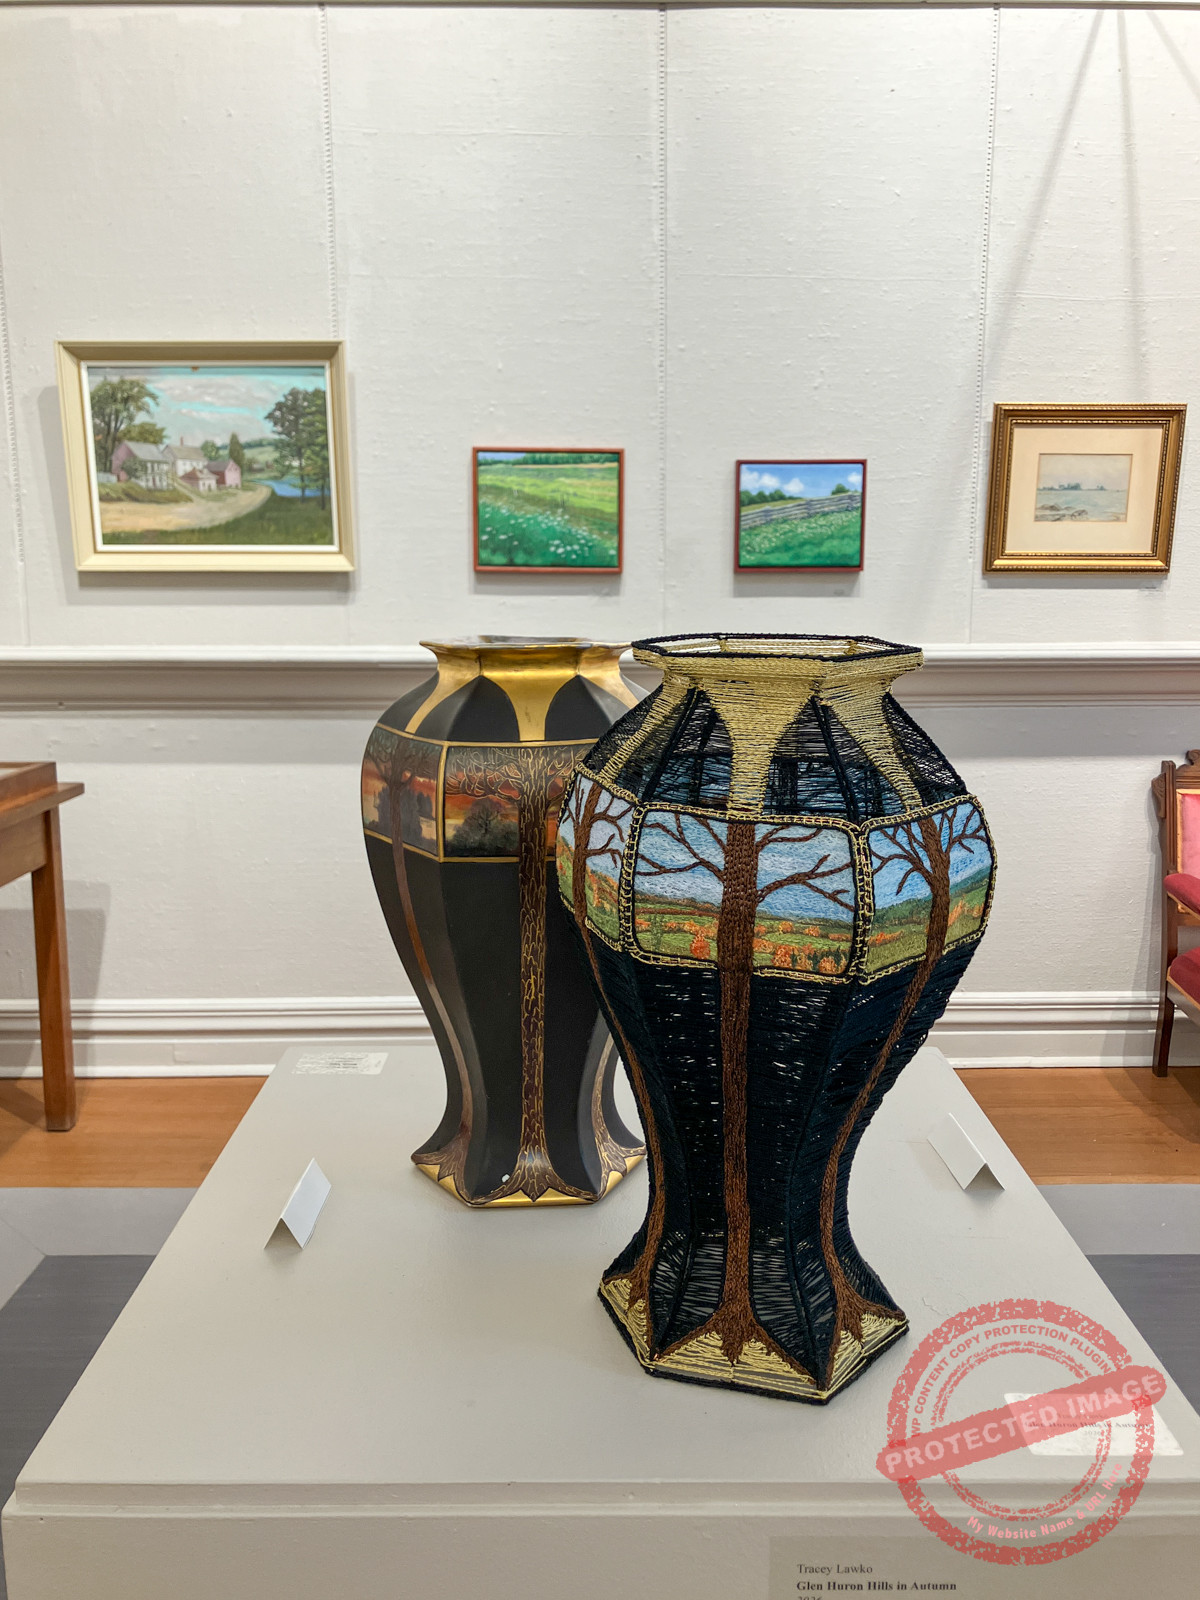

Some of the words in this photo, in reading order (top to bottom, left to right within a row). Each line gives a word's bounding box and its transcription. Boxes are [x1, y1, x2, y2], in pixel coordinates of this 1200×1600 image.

[797, 1564, 832, 1574] Tracey
[836, 1564, 873, 1574] Lawko
[796, 1581, 823, 1591] Glen
[827, 1581, 864, 1591] Huron
[867, 1581, 894, 1591] Hills
[896, 1581, 907, 1591] in
[910, 1581, 957, 1591] Autumn
